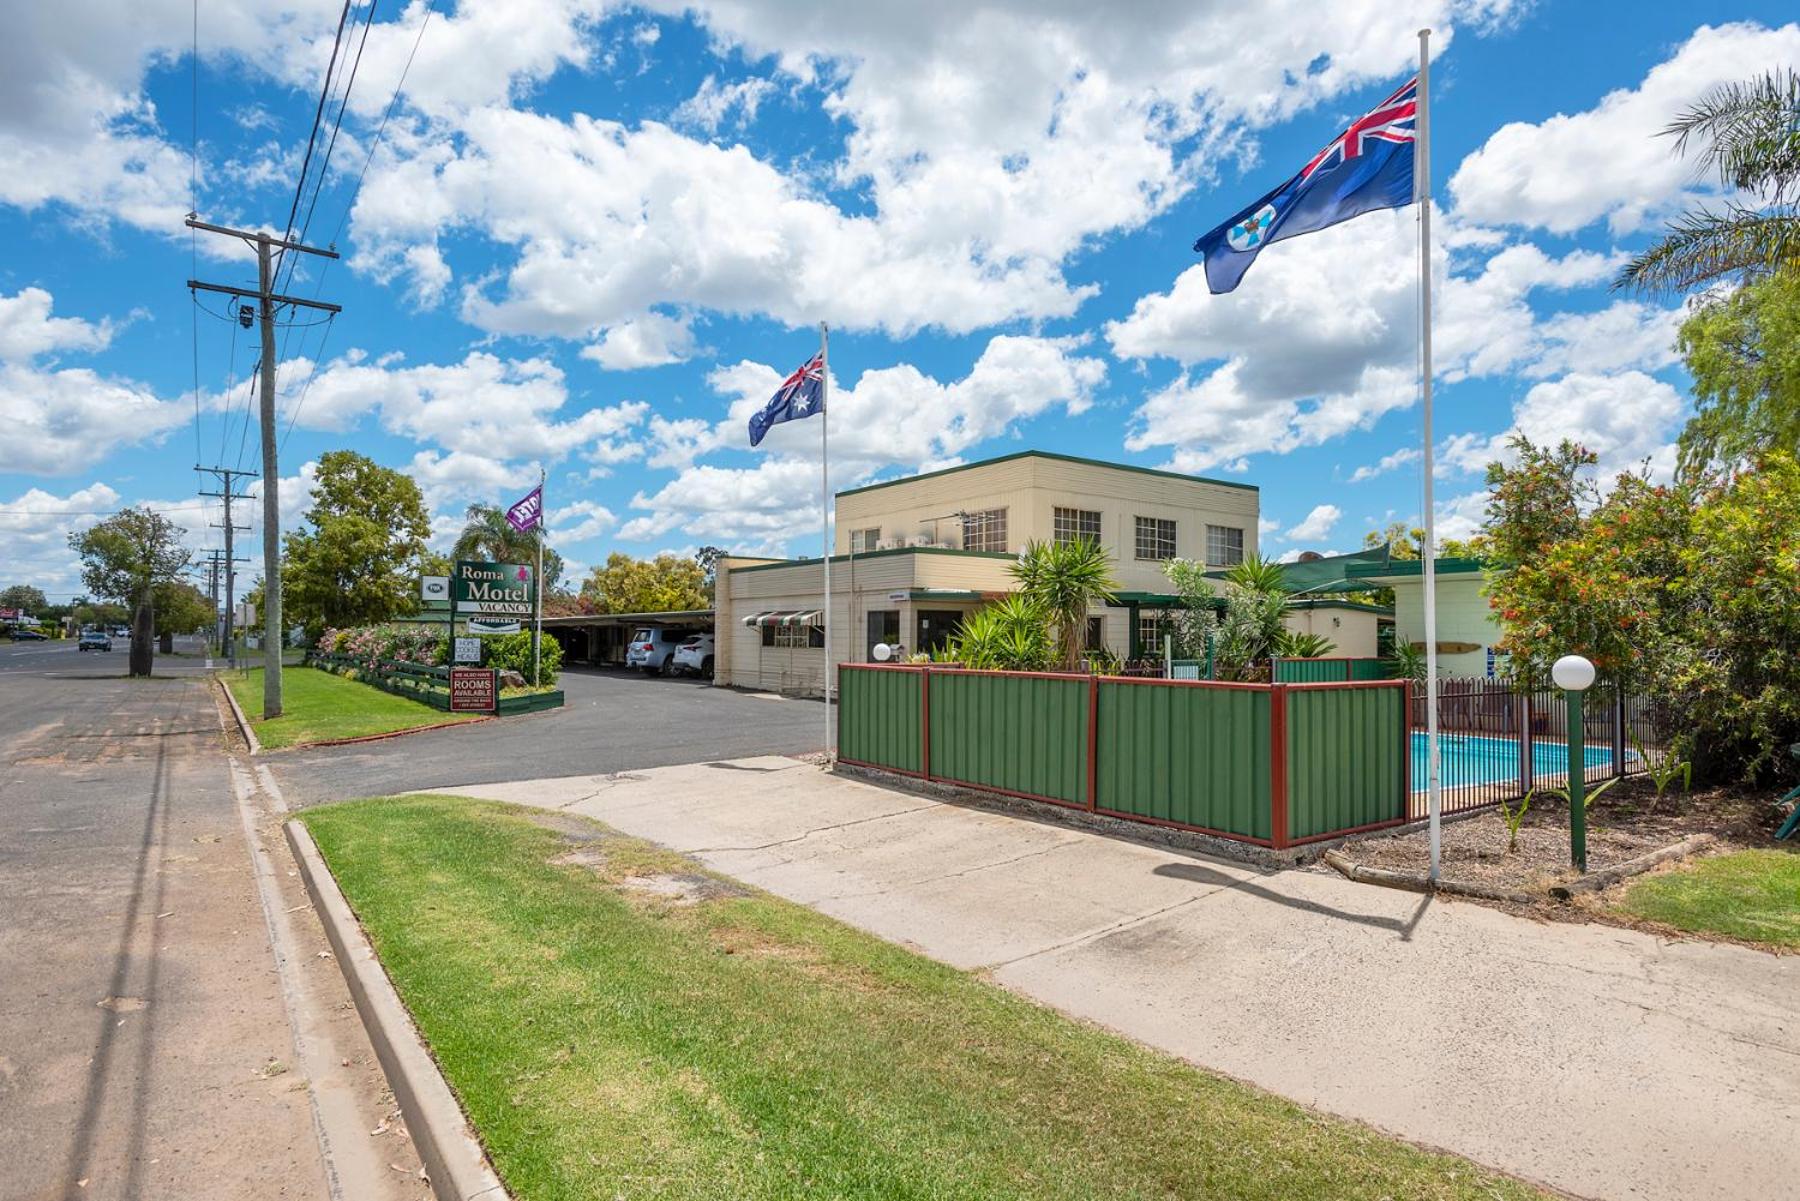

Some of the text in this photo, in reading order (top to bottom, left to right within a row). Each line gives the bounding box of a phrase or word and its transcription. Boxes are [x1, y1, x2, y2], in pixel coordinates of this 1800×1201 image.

[462, 565, 504, 580] Roma
[467, 581, 529, 602] Motel
[479, 602, 529, 612] VACANCY
[454, 680, 492, 690] ROOMS
[454, 689, 492, 697] AVAILABLE
